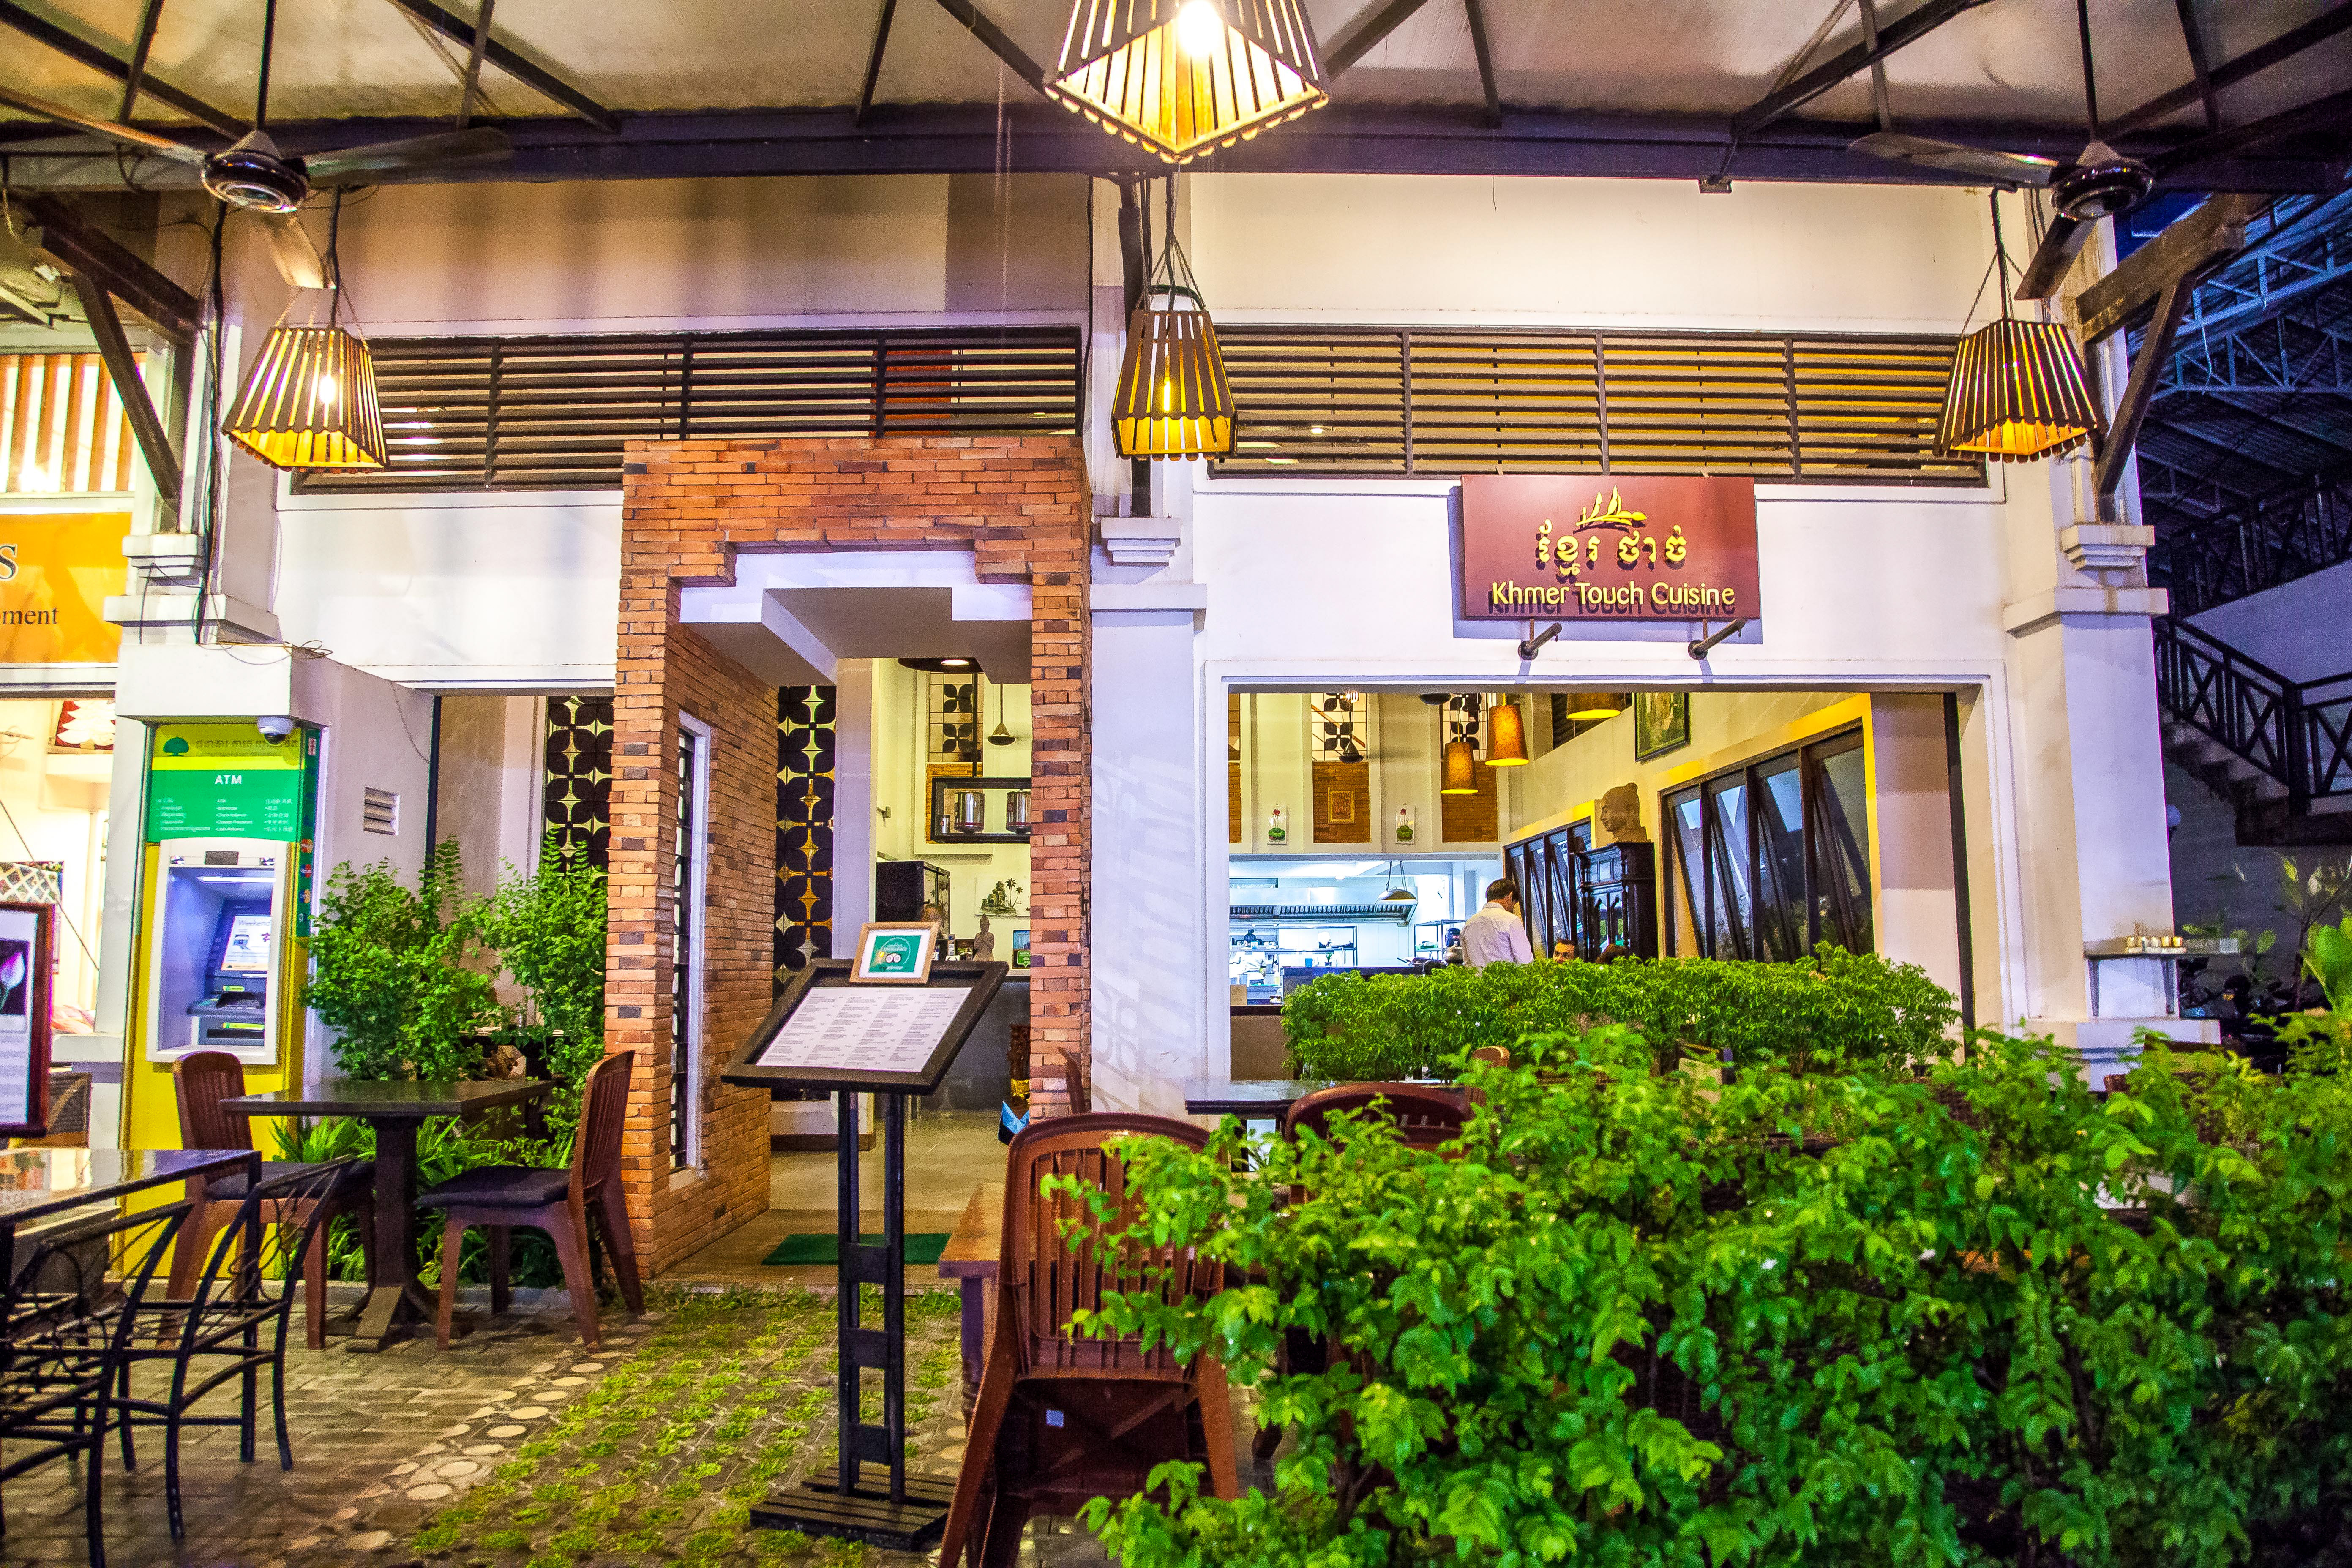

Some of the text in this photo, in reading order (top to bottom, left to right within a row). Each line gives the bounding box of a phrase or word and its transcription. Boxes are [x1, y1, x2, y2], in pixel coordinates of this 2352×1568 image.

[1492, 580, 1735, 605] Khmer Touch Cuisine
[0, 607, 59, 625] ment
[215, 774, 242, 785] ATM
